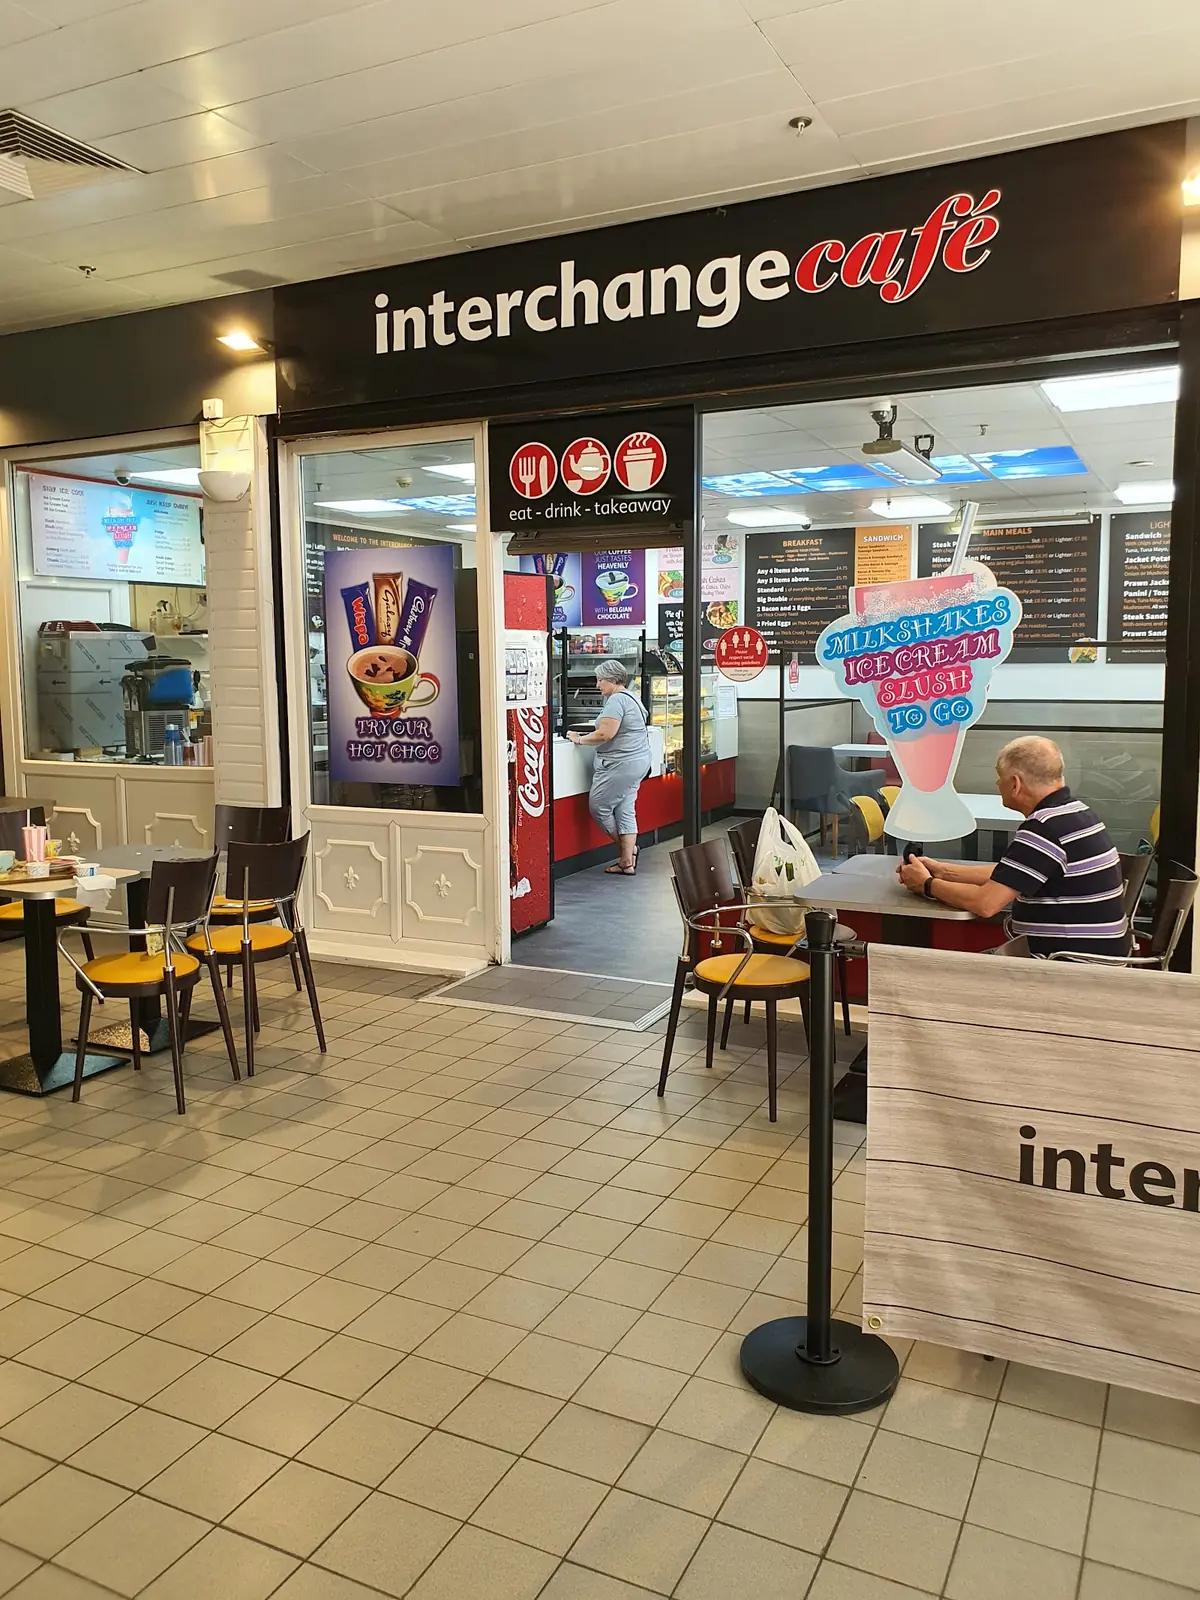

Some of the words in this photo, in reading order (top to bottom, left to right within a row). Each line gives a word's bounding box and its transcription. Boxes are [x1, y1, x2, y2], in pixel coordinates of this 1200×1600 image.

[509, 506, 533, 521] eat
[544, 501, 582, 519] drink
[594, 498, 672, 516] takeaway
[983, 529, 1004, 537] MAIN
[1005, 528, 1032, 536] MEALS
[1150, 521, 1170, 529] LIGH
[332, 534, 358, 544] WELCOME
[369, 538, 378, 546] THE
[782, 538, 824, 548] BREAKFAST
[863, 534, 904, 542] SANDWICH
[595, 555, 610, 563] JUST
[610, 554, 632, 562] TASTES
[598, 562, 629, 570] HEAVENLY
[1124, 556, 1150, 564] Jacket
[352, 596, 369, 645] Wispa
[380, 589, 396, 638] Galaxy
[827, 599, 1008, 657] MILKSHAKES
[847, 654, 891, 681] ICE
[895, 631, 997, 671] CREAM
[881, 669, 969, 705] SLUSH
[890, 708, 925, 730] TO
[934, 700, 969, 721] GO
[358, 719, 390, 736] TRY
[392, 720, 430, 738] OUR
[349, 743, 386, 758] HOT
[390, 744, 439, 760] CHOC
